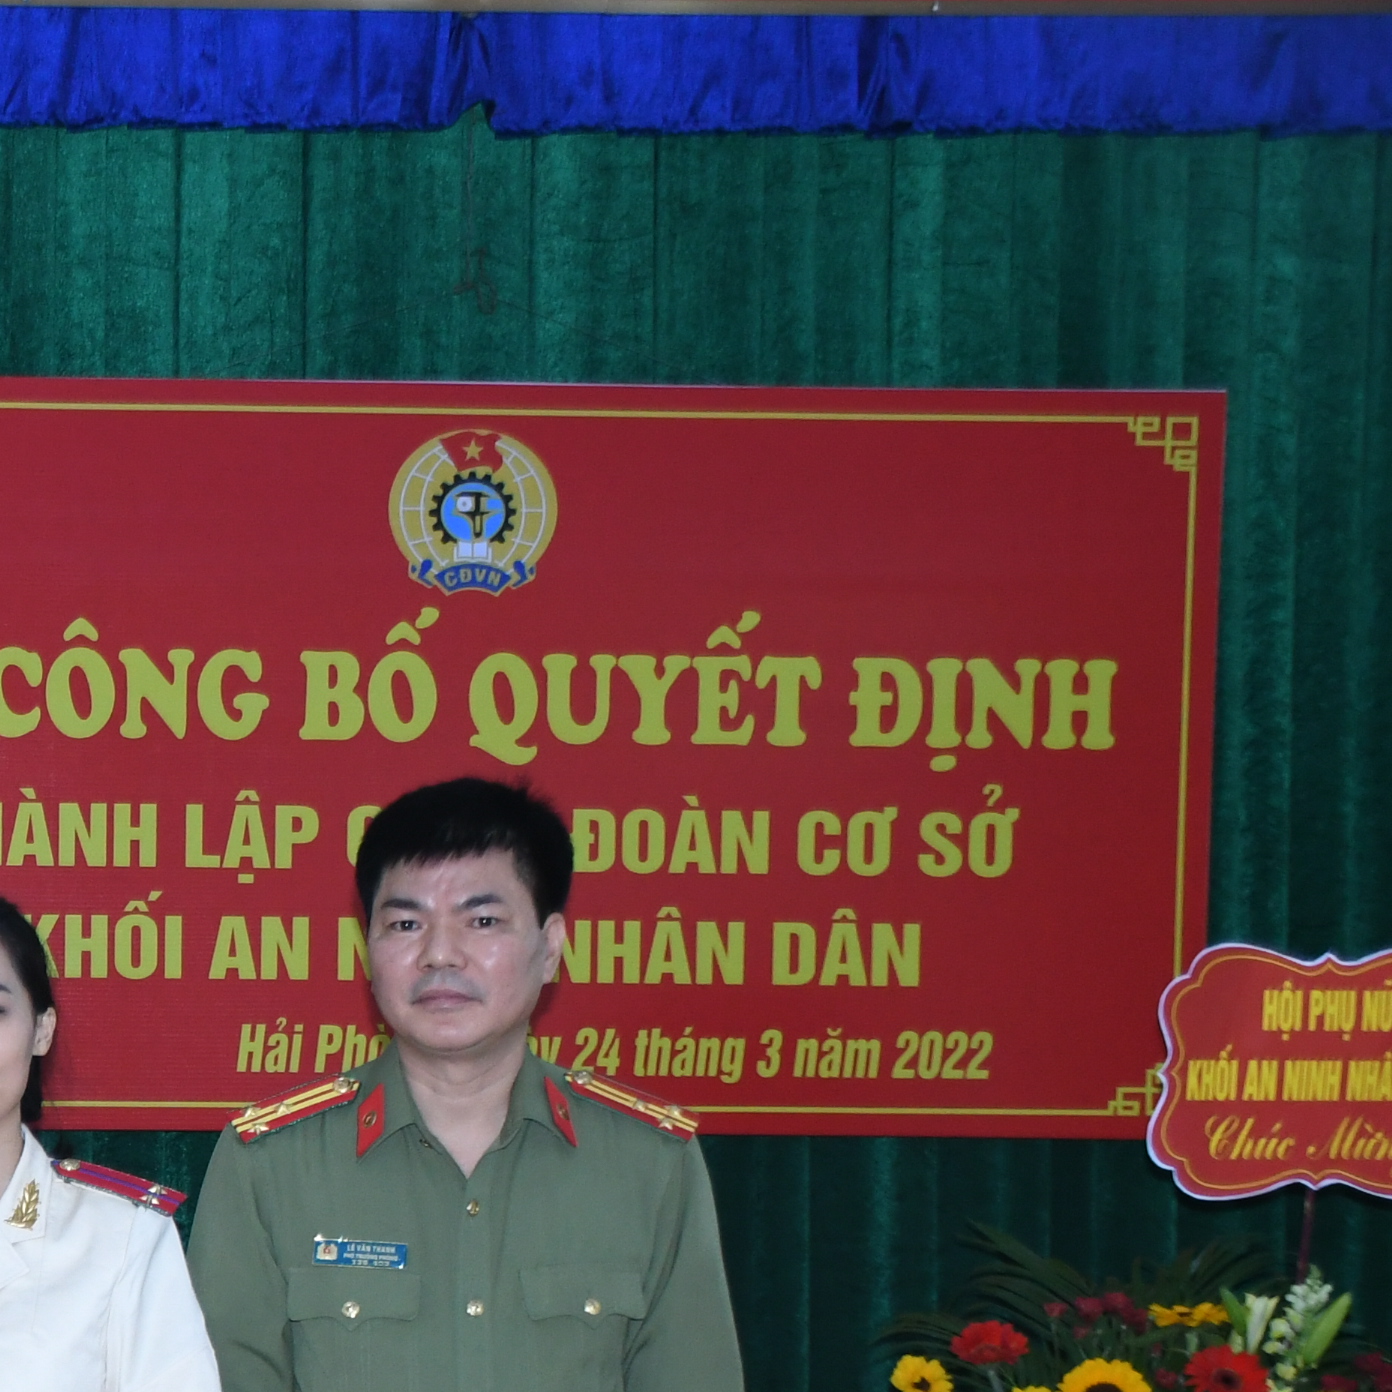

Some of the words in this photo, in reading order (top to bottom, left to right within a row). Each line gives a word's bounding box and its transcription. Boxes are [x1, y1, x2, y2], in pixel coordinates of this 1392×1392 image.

[444, 567, 502, 587] CĐVN
[299, 606, 440, 742] BỐ
[468, 610, 822, 765] QUYẾT
[849, 656, 1118, 772] ĐỊNH
[185, 789, 319, 883] LẬP
[570, 795, 770, 875] ĐOÀN
[797, 806, 898, 877] CƠ
[918, 784, 1020, 878] SỞ
[208, 915, 310, 980] AN
[551, 906, 745, 985] NHÂN
[771, 907, 921, 987] DÂN
[1261, 980, 1304, 1042] HỘI
[1308, 988, 1358, 1042] PHỤ
[236, 1017, 304, 1074] Hải
[571, 1027, 621, 1076] 24
[633, 1026, 746, 1084] tháng
[756, 1028, 783, 1077] 3
[793, 1027, 881, 1078] năm
[892, 1029, 993, 1080] 2022
[1186, 1044, 1239, 1101] KHỐI
[1242, 1059, 1279, 1101] AN
[1282, 1060, 1343, 1101] NINH
[1204, 1114, 1296, 1160] Chúc
